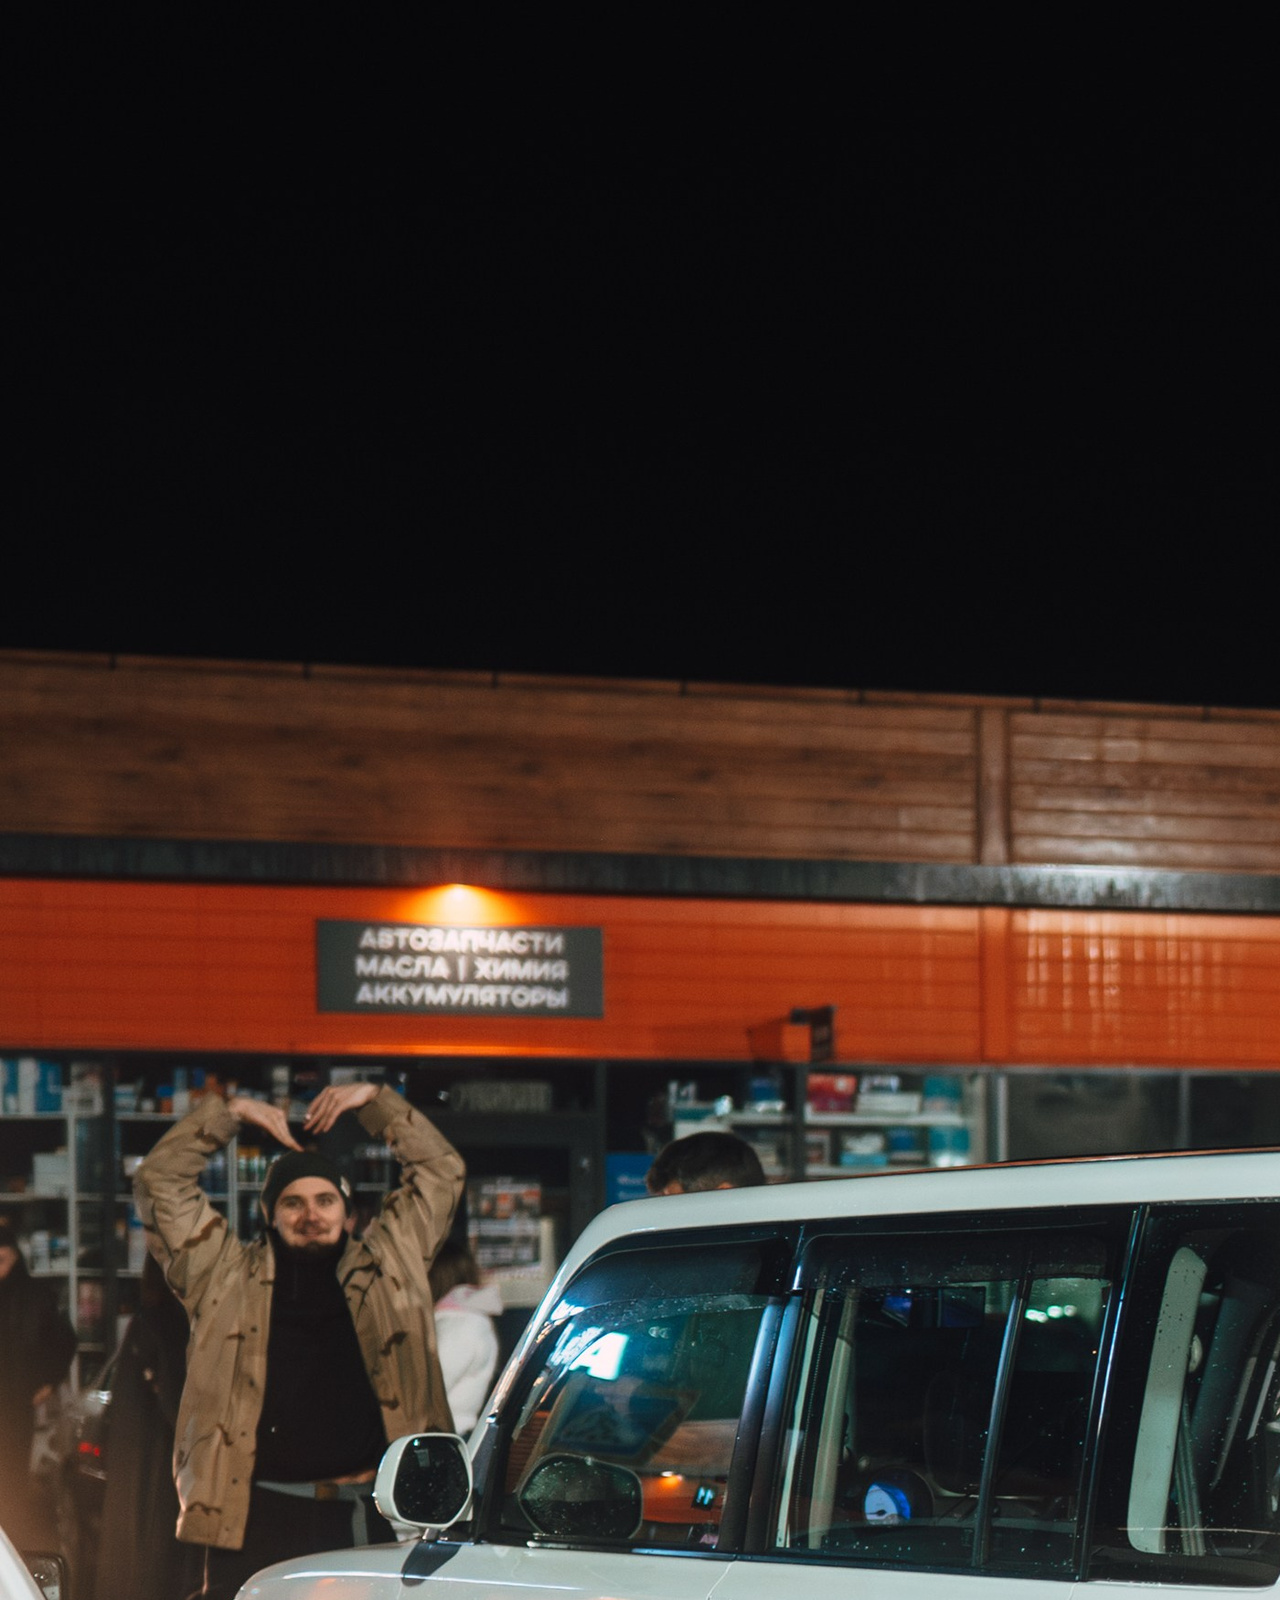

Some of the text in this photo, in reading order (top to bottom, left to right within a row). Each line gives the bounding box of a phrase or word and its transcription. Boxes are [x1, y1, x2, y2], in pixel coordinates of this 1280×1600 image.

[358, 927, 564, 955] АВТОЗАПЧАСТИ
[354, 954, 569, 982] МАСЛА ХИМИЯ
[355, 982, 569, 1009] АККУМУЛЯТОРЫ
